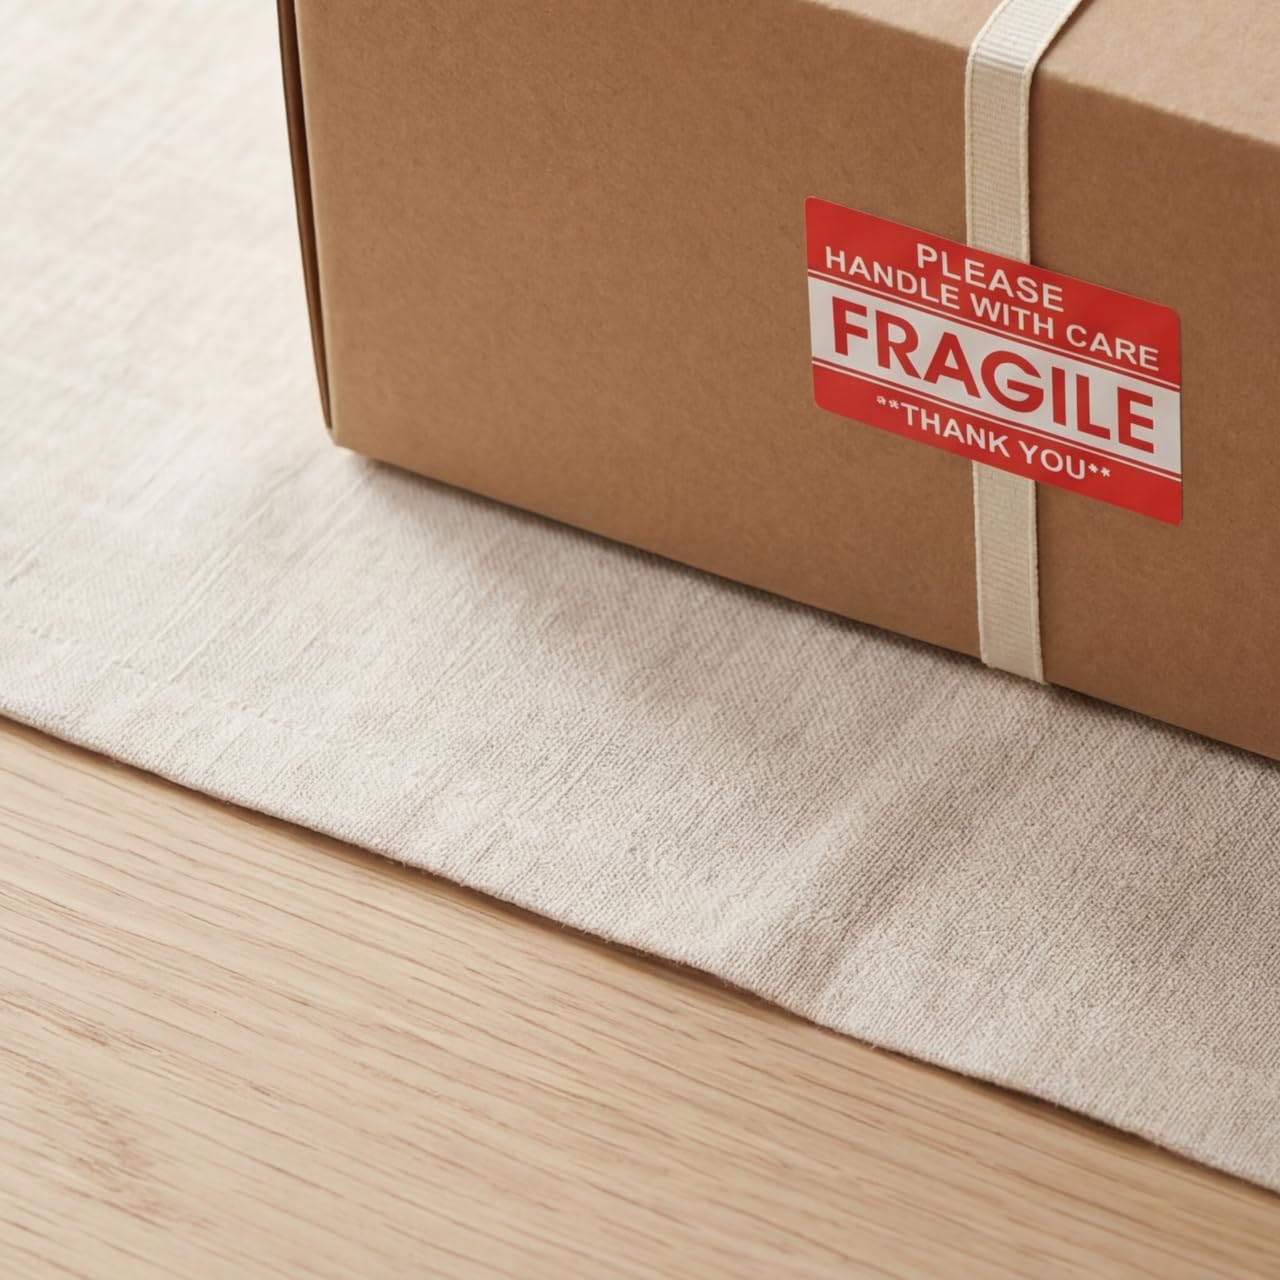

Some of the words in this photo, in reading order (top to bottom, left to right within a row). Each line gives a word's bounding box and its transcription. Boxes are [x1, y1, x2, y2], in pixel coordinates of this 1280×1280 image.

[825, 245, 960, 310] HANDLE
[970, 292, 1055, 340] WITH
[1066, 323, 1160, 373] CARE
[916, 242, 1065, 313] PLEASE
[832, 295, 1155, 455] FRAGILE
